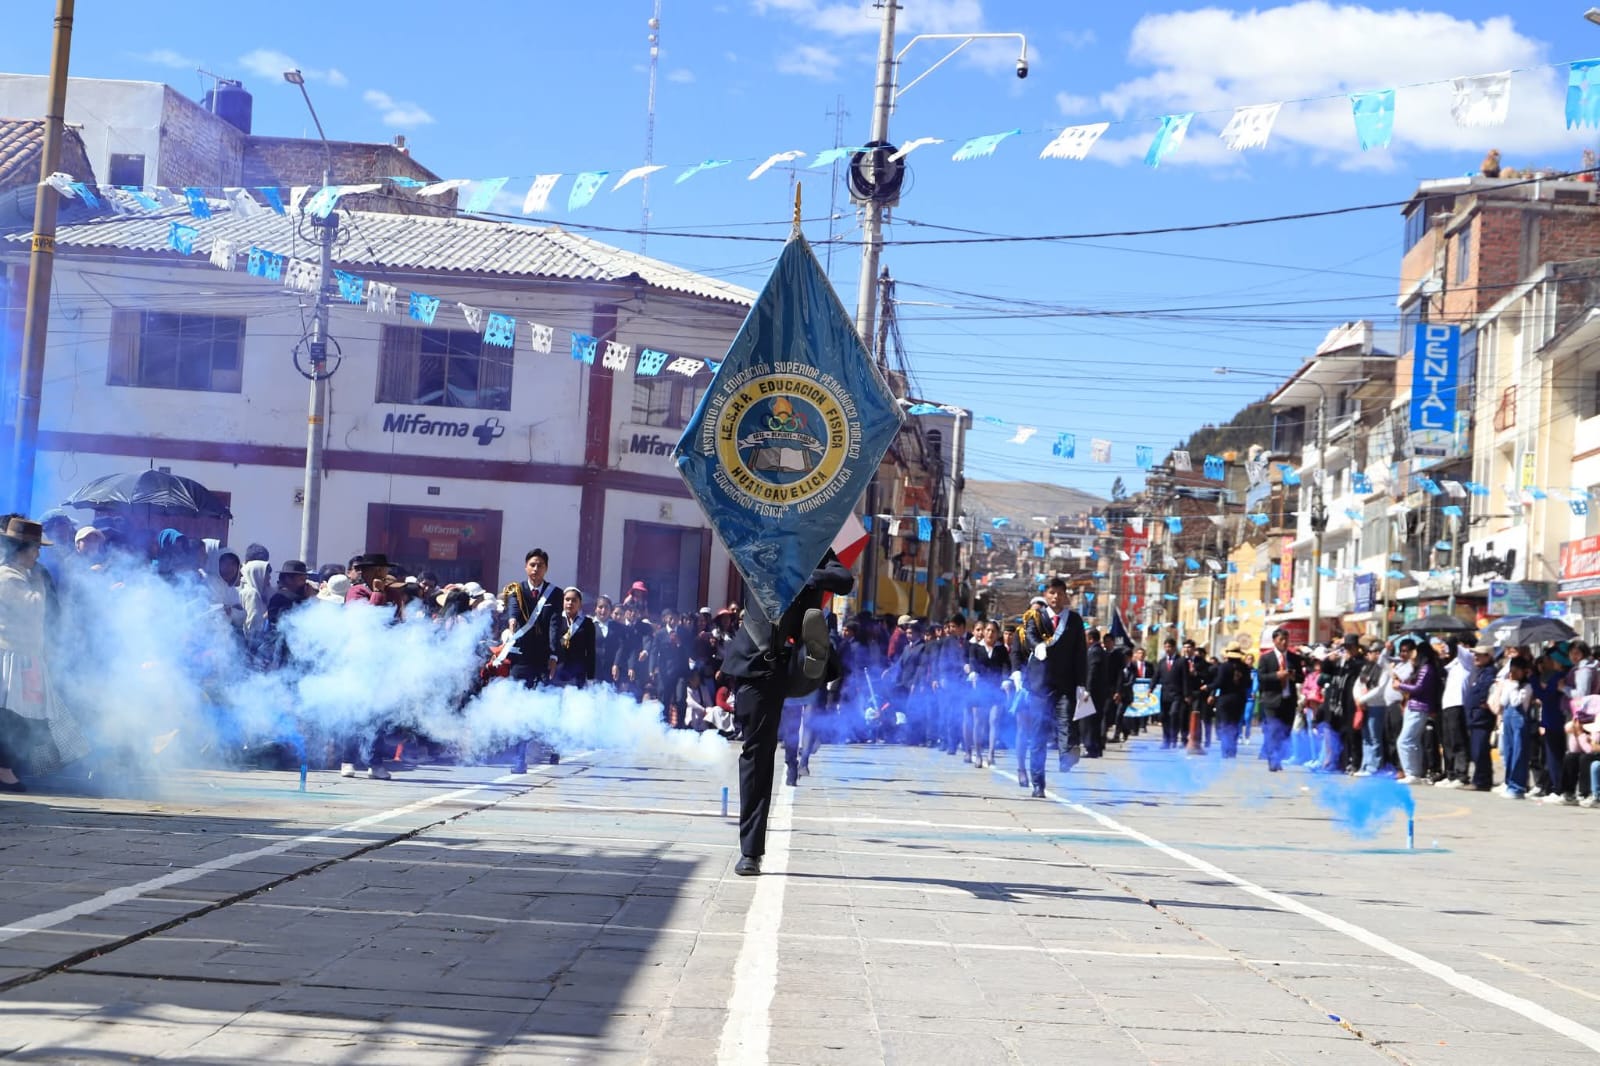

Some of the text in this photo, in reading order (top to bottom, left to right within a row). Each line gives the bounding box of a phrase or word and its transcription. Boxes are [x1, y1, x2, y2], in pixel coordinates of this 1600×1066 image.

[1420, 325, 1450, 428] DENTAL
[383, 413, 470, 437] Mifarma
[703, 408, 719, 457] INSTITUTO
[712, 393, 727, 408] DE
[774, 361, 820, 380] SUPERIOR
[731, 466, 827, 500] HUANCAVELICA
[797, 467, 853, 514] HUANCAVELICA
